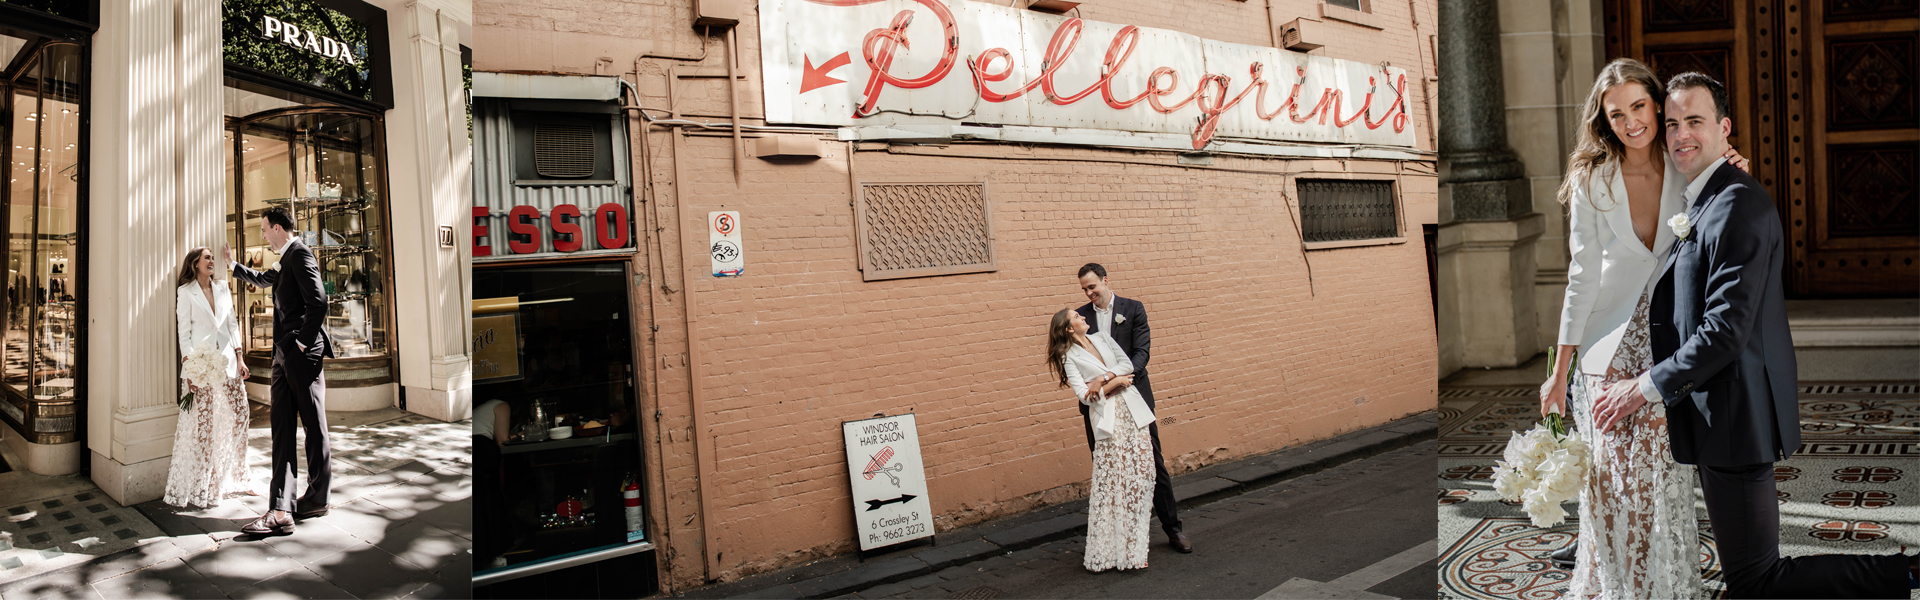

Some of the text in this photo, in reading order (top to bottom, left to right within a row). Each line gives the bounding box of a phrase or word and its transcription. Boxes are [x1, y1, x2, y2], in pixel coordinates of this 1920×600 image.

[262, 15, 355, 65] PRADA
[804, 0, 1412, 150] Pellegrini's
[472, 202, 628, 256] ESSO
[472, 359, 499, 376] offee
[862, 421, 899, 434] WINDSOR
[860, 431, 905, 446] HAIR SALON
[871, 511, 919, 529] 6 Crossley St
[869, 523, 925, 543] Ph: 9662 3273
